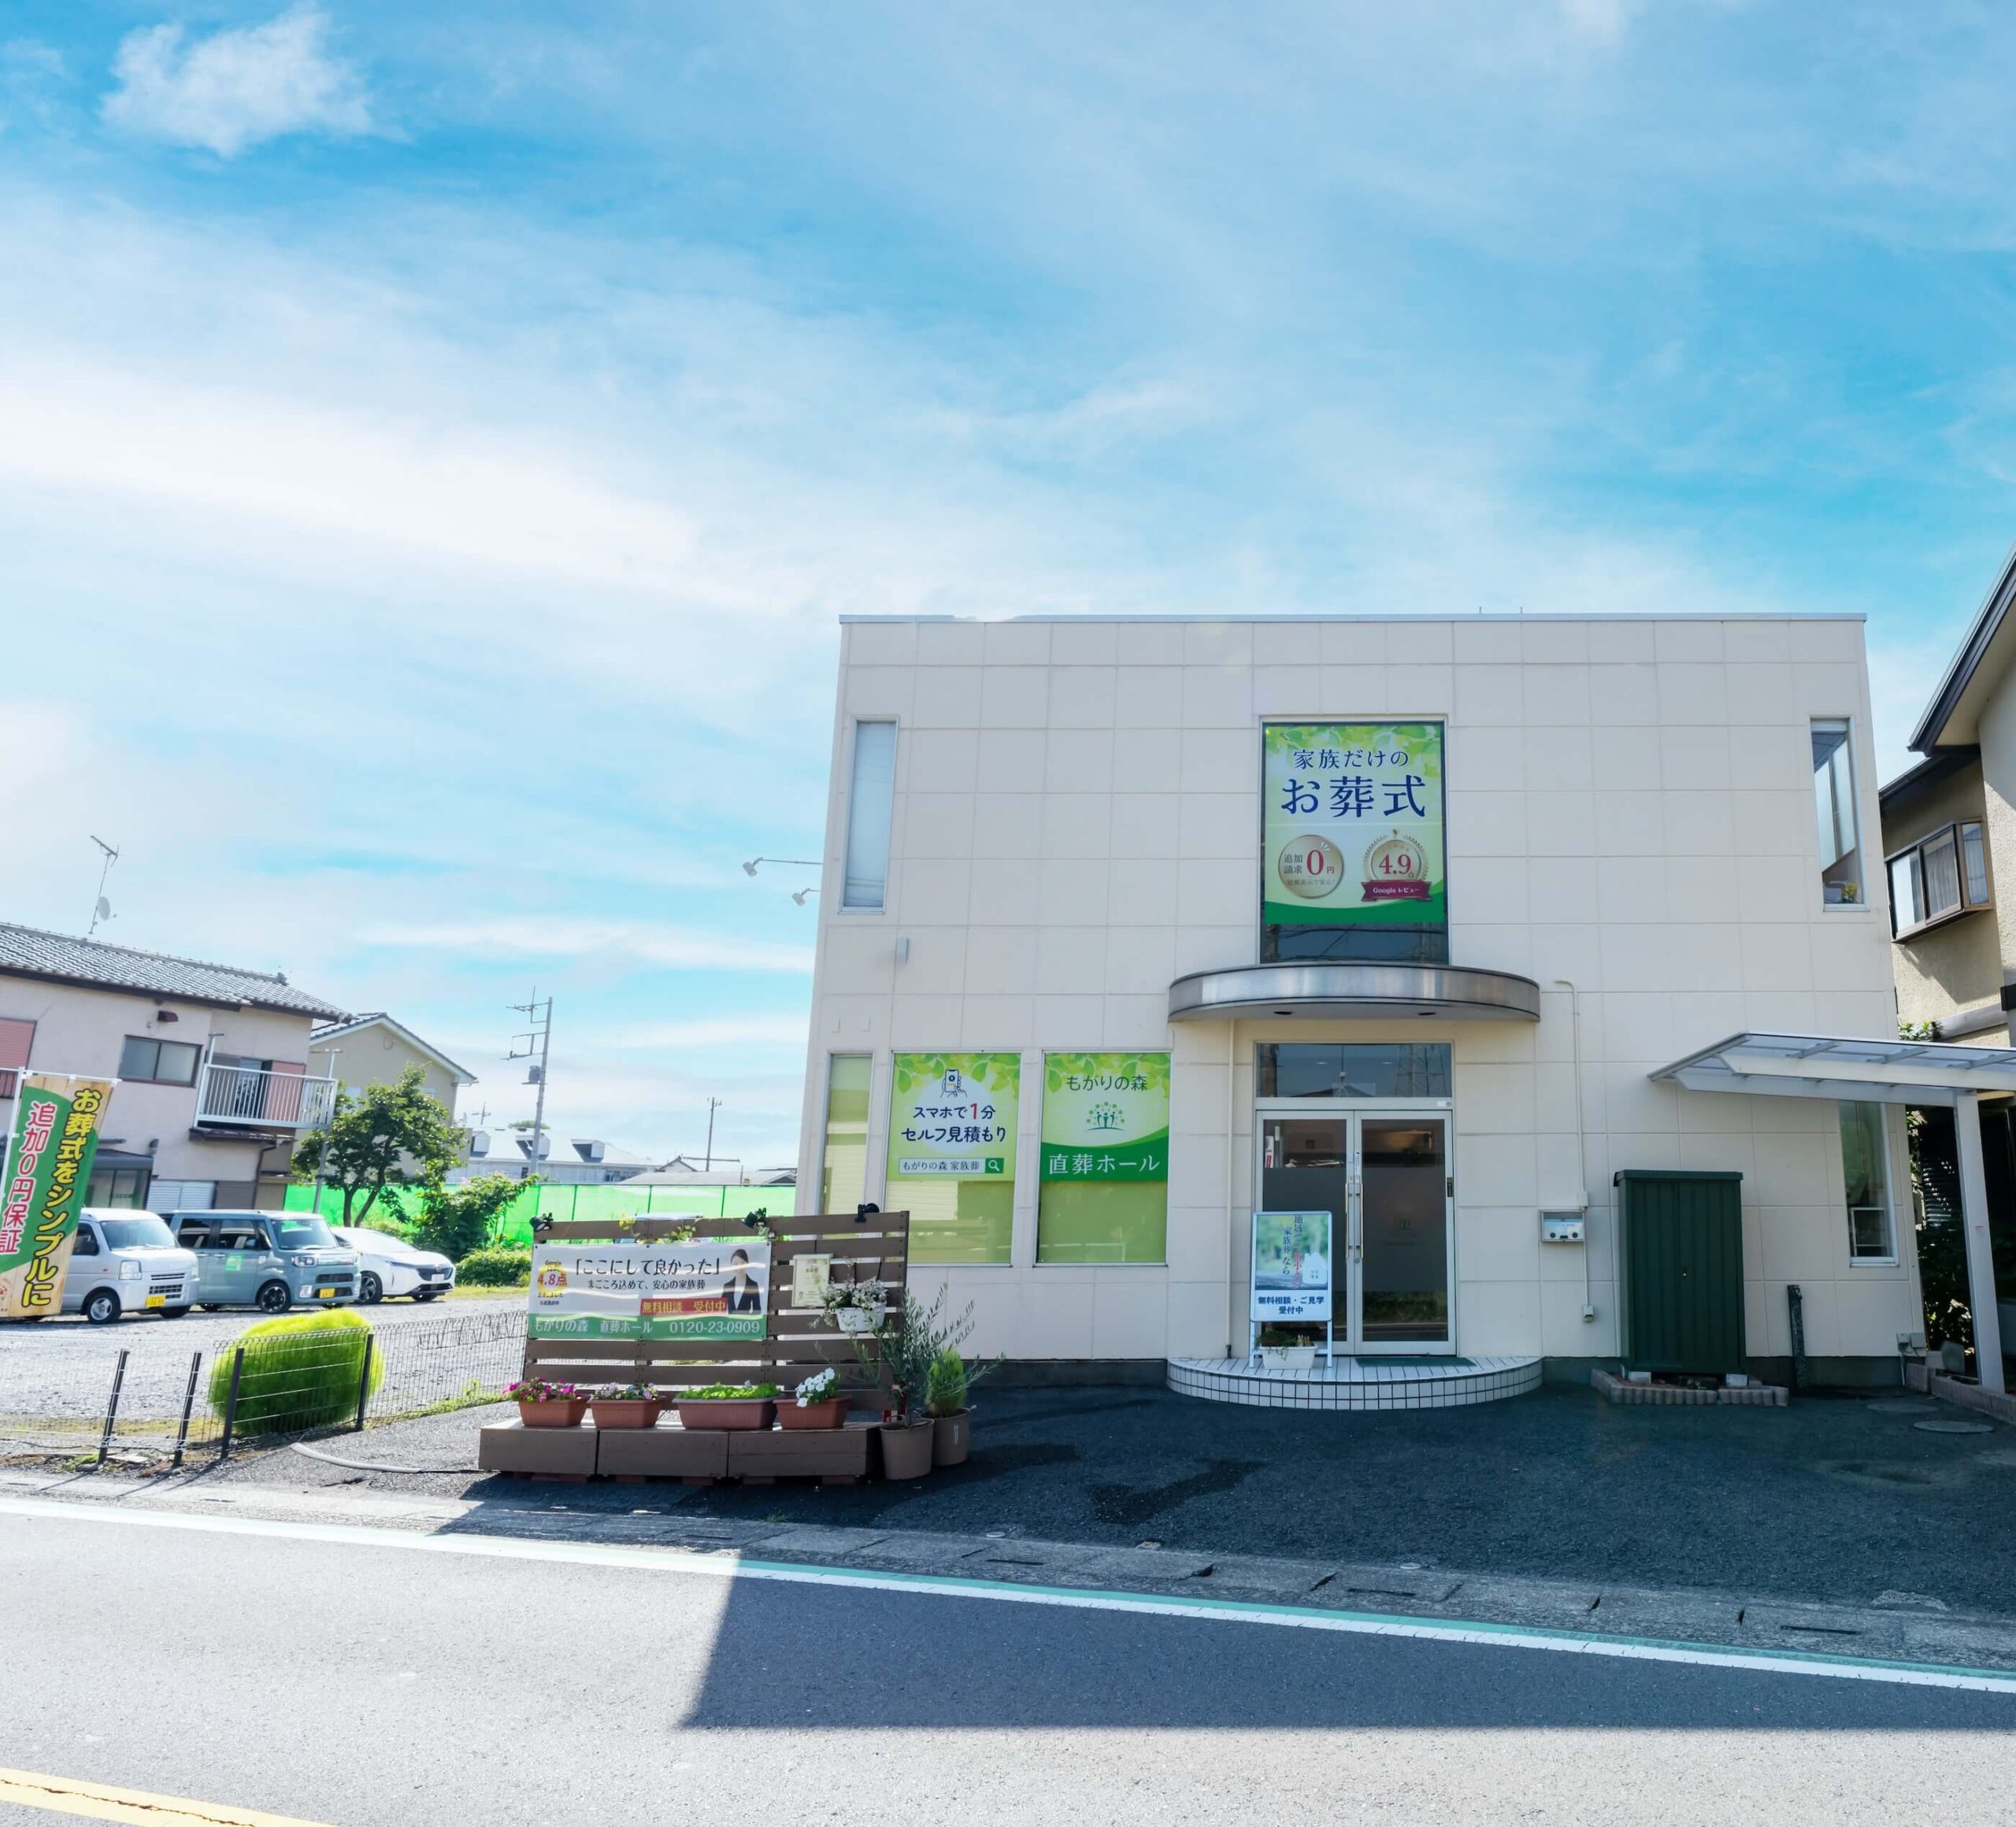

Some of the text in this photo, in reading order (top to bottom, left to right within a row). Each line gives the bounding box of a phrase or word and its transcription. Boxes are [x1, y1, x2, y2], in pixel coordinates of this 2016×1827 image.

[1293, 749, 1410, 769] 家族だけの
[1280, 774, 1426, 817] お葬式
[1284, 854, 1303, 864] 追加
[1378, 854, 1411, 875] 4.9
[1284, 865, 1303, 875] 請求
[1065, 1075, 1148, 1092] もがりの森
[913, 1102, 996, 1120] スマホで1分
[901, 1125, 1006, 1143] セルフ見積もり
[902, 1161, 980, 1171] もがりの森 家族葬
[1048, 1153, 1161, 1176] 直葬ホール
[21, 1088, 102, 1308] お葬式をシンプルに
[537, 1273, 568, 1286] 4.8点
[642, 1300, 726, 1314] 無料相談 受付中
[1258, 1295, 1325, 1305] 無料相談・ご見学
[1278, 1306, 1304, 1314] 受付中
[536, 1318, 761, 1334] もがりの森 直葬ホール 0120-23-0909
